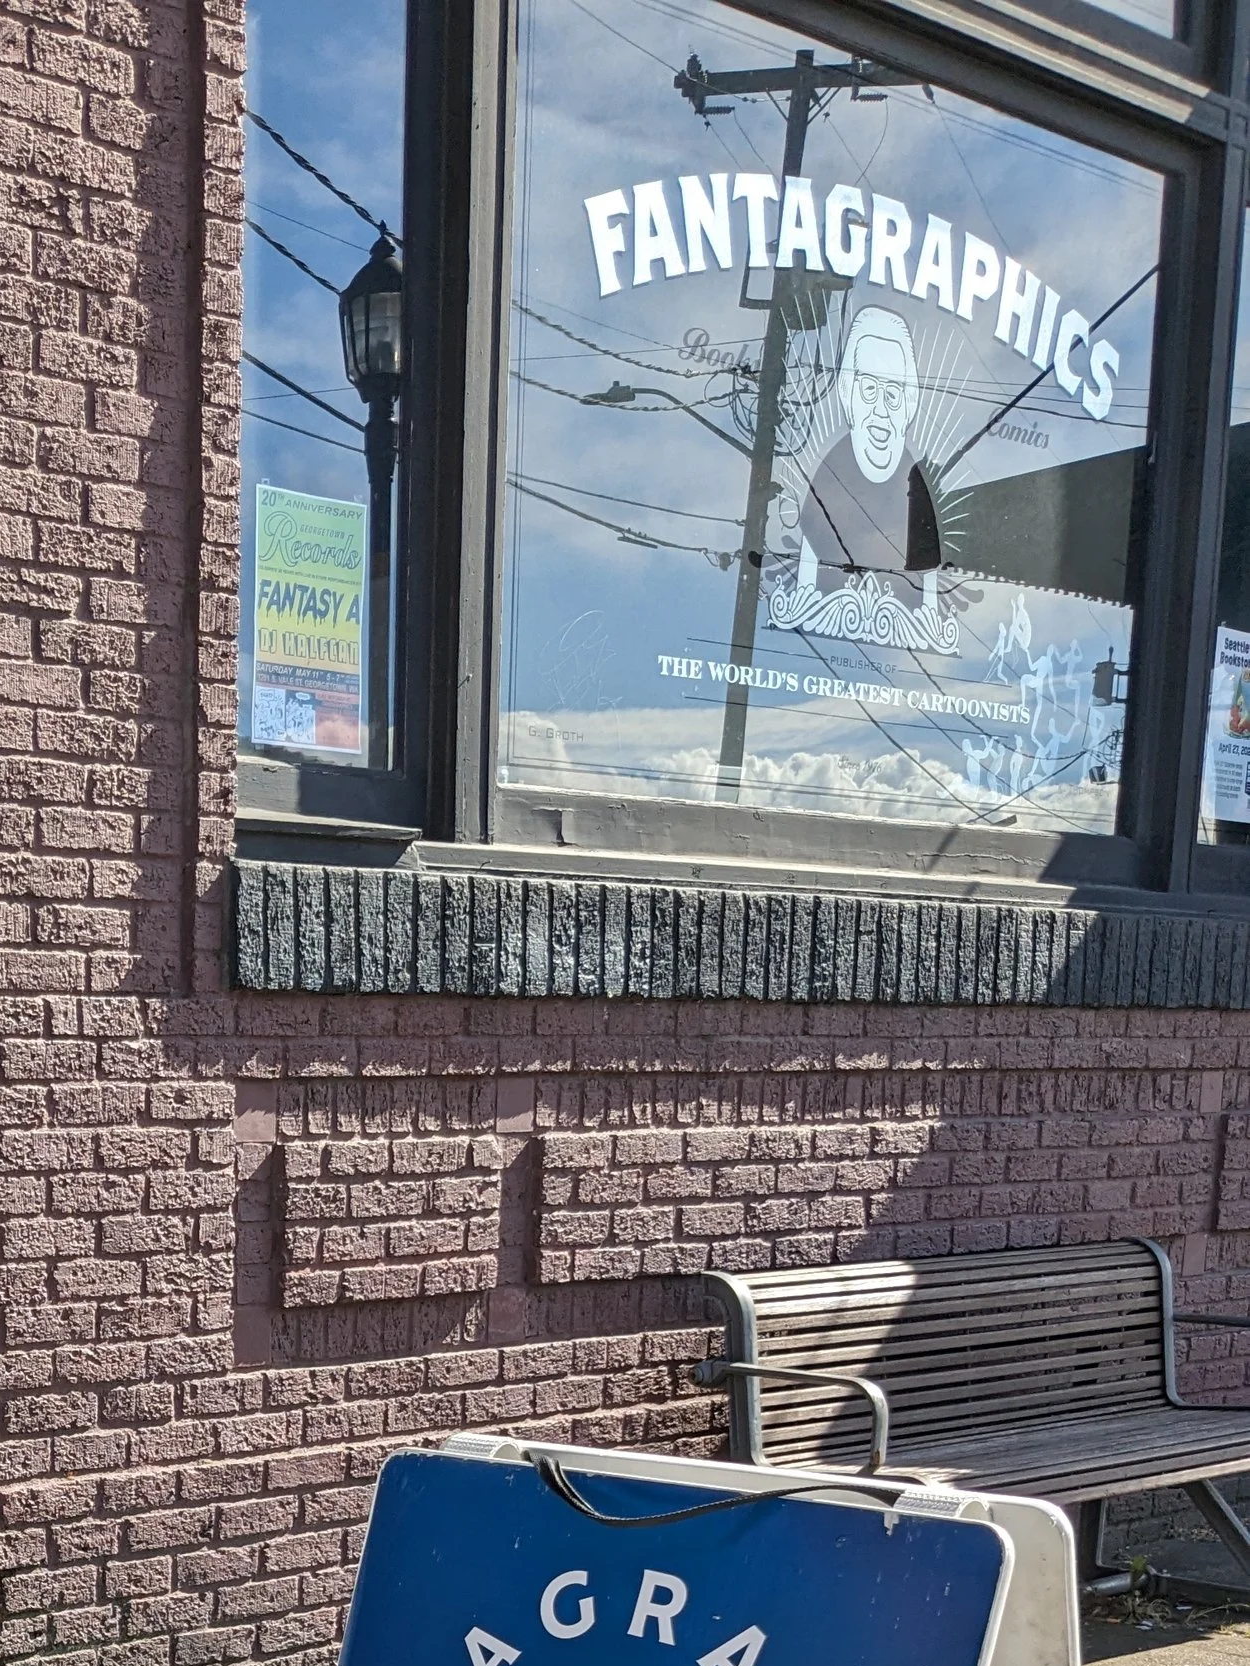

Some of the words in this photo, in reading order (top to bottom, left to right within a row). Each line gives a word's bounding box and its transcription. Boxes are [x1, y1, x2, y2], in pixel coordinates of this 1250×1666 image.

[583, 172, 1120, 422] FANTAGRAPHICS
[987, 405, 1049, 450] Comics
[285, 499, 363, 521] ANNIVERSARY
[258, 510, 362, 570] Records
[300, 524, 345, 540] GEORGETOWN
[258, 579, 345, 628] FANTASY
[346, 594, 361, 625] A
[258, 628, 277, 654] DJ
[1224, 637, 1250, 654] Seattle
[256, 663, 293, 674] SATURDAY
[296, 668, 311, 677] MAY
[830, 656, 884, 673] PUBLISHER
[885, 664, 897, 674] OF
[658, 655, 703, 681] THE
[707, 660, 799, 693] WORLD'S
[803, 675, 904, 708] GREATEST
[906, 690, 1031, 725] CARTOONISTS
[528, 725, 541, 737] G.
